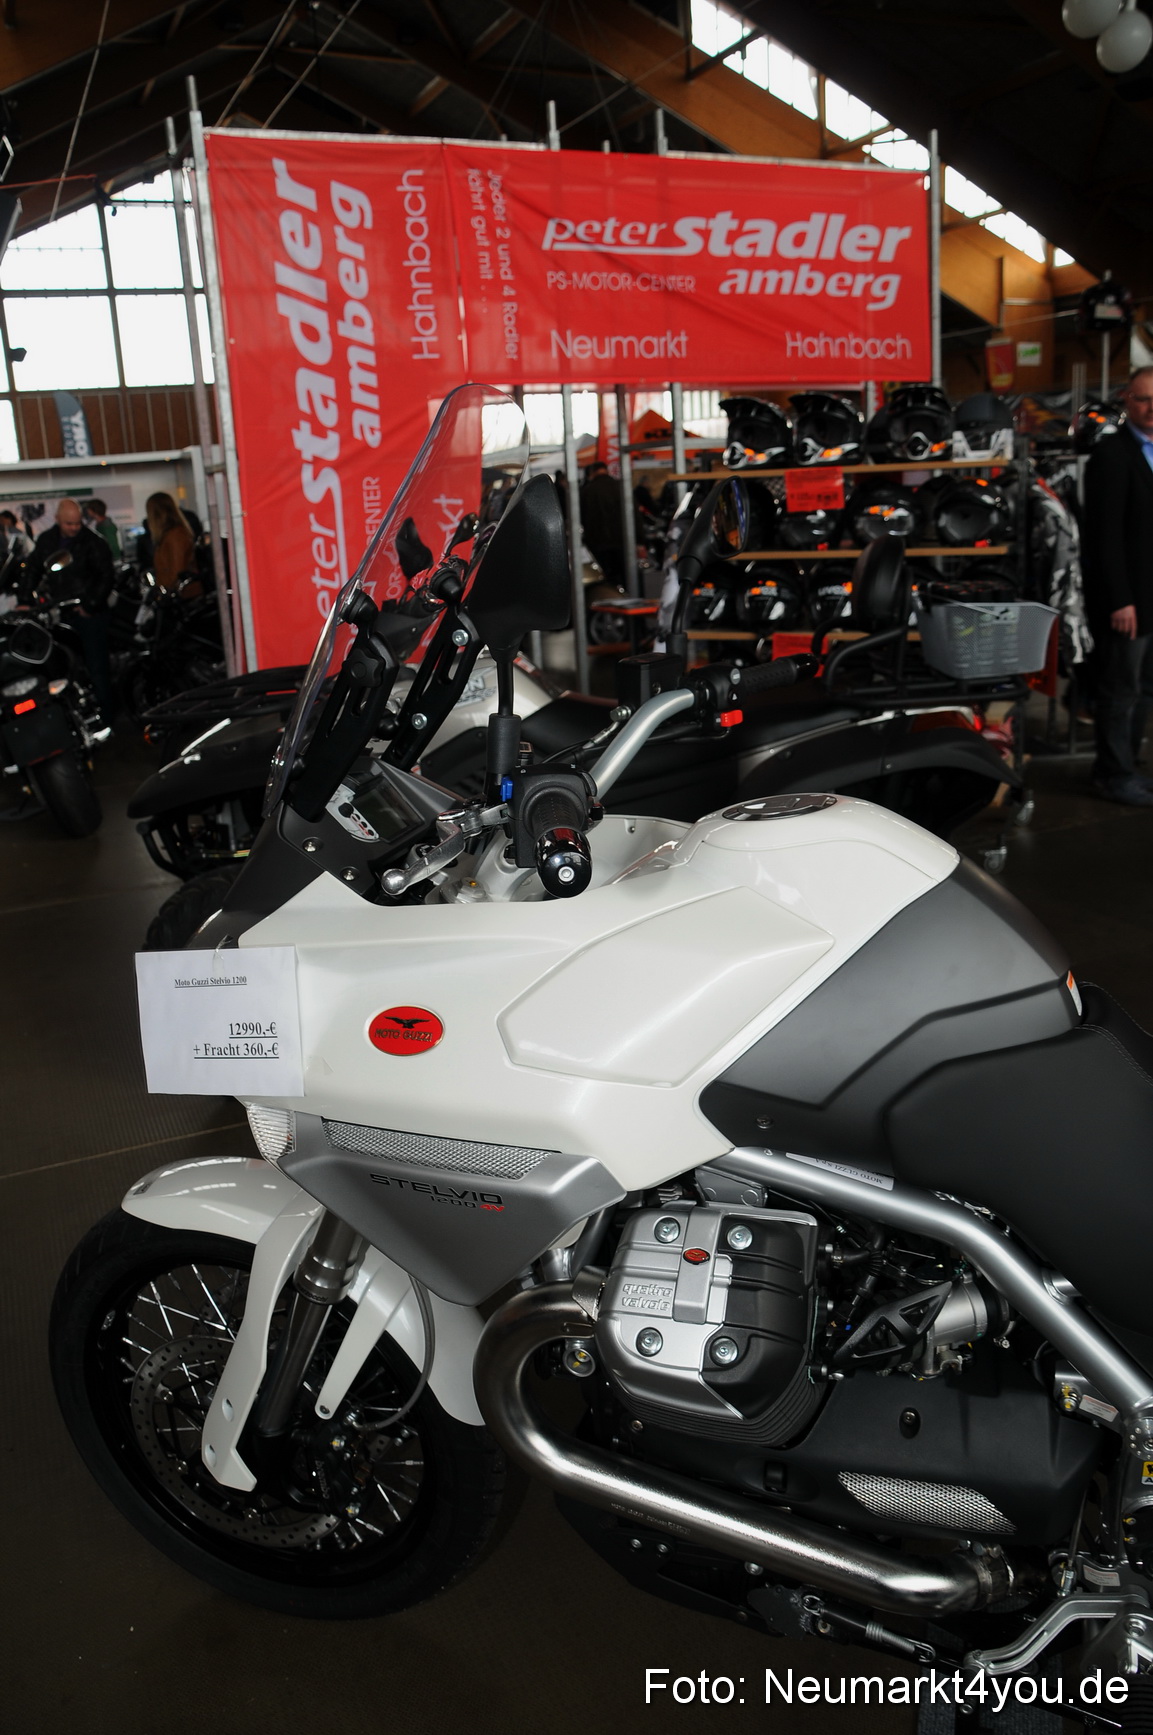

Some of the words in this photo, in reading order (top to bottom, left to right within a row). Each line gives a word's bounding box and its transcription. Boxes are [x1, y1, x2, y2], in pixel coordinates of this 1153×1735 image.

[487, 170, 507, 222] Jeder
[470, 216, 490, 247] gut
[496, 227, 511, 239] 2
[542, 217, 668, 250] peter
[673, 211, 912, 262] stadler
[396, 169, 440, 360] Hahnbach
[477, 251, 494, 280] mit
[497, 243, 515, 281] und
[502, 285, 516, 297] 4
[718, 264, 902, 311] amberg
[330, 179, 382, 448] amberg
[272, 157, 341, 504] stadler
[550, 329, 688, 359] Neumarkt
[785, 331, 912, 360] Hahnbach
[308, 513, 340, 620] eter
[174, 978, 190, 987] Moto
[191, 977, 209, 986] Guzzi
[209, 976, 231, 985] Stelvio
[232, 975, 247, 984] 1200
[229, 1021, 277, 1037] 12990,-€
[374, 1028, 401, 1039] MOTO
[402, 1030, 433, 1042] GUZZI
[203, 1043, 240, 1056] Fracht
[243, 1042, 279, 1057] 360,-€
[369, 1173, 503, 1205] STELVIO
[430, 1195, 477, 1209] 1200
[621, 1296, 671, 1311] valvole
